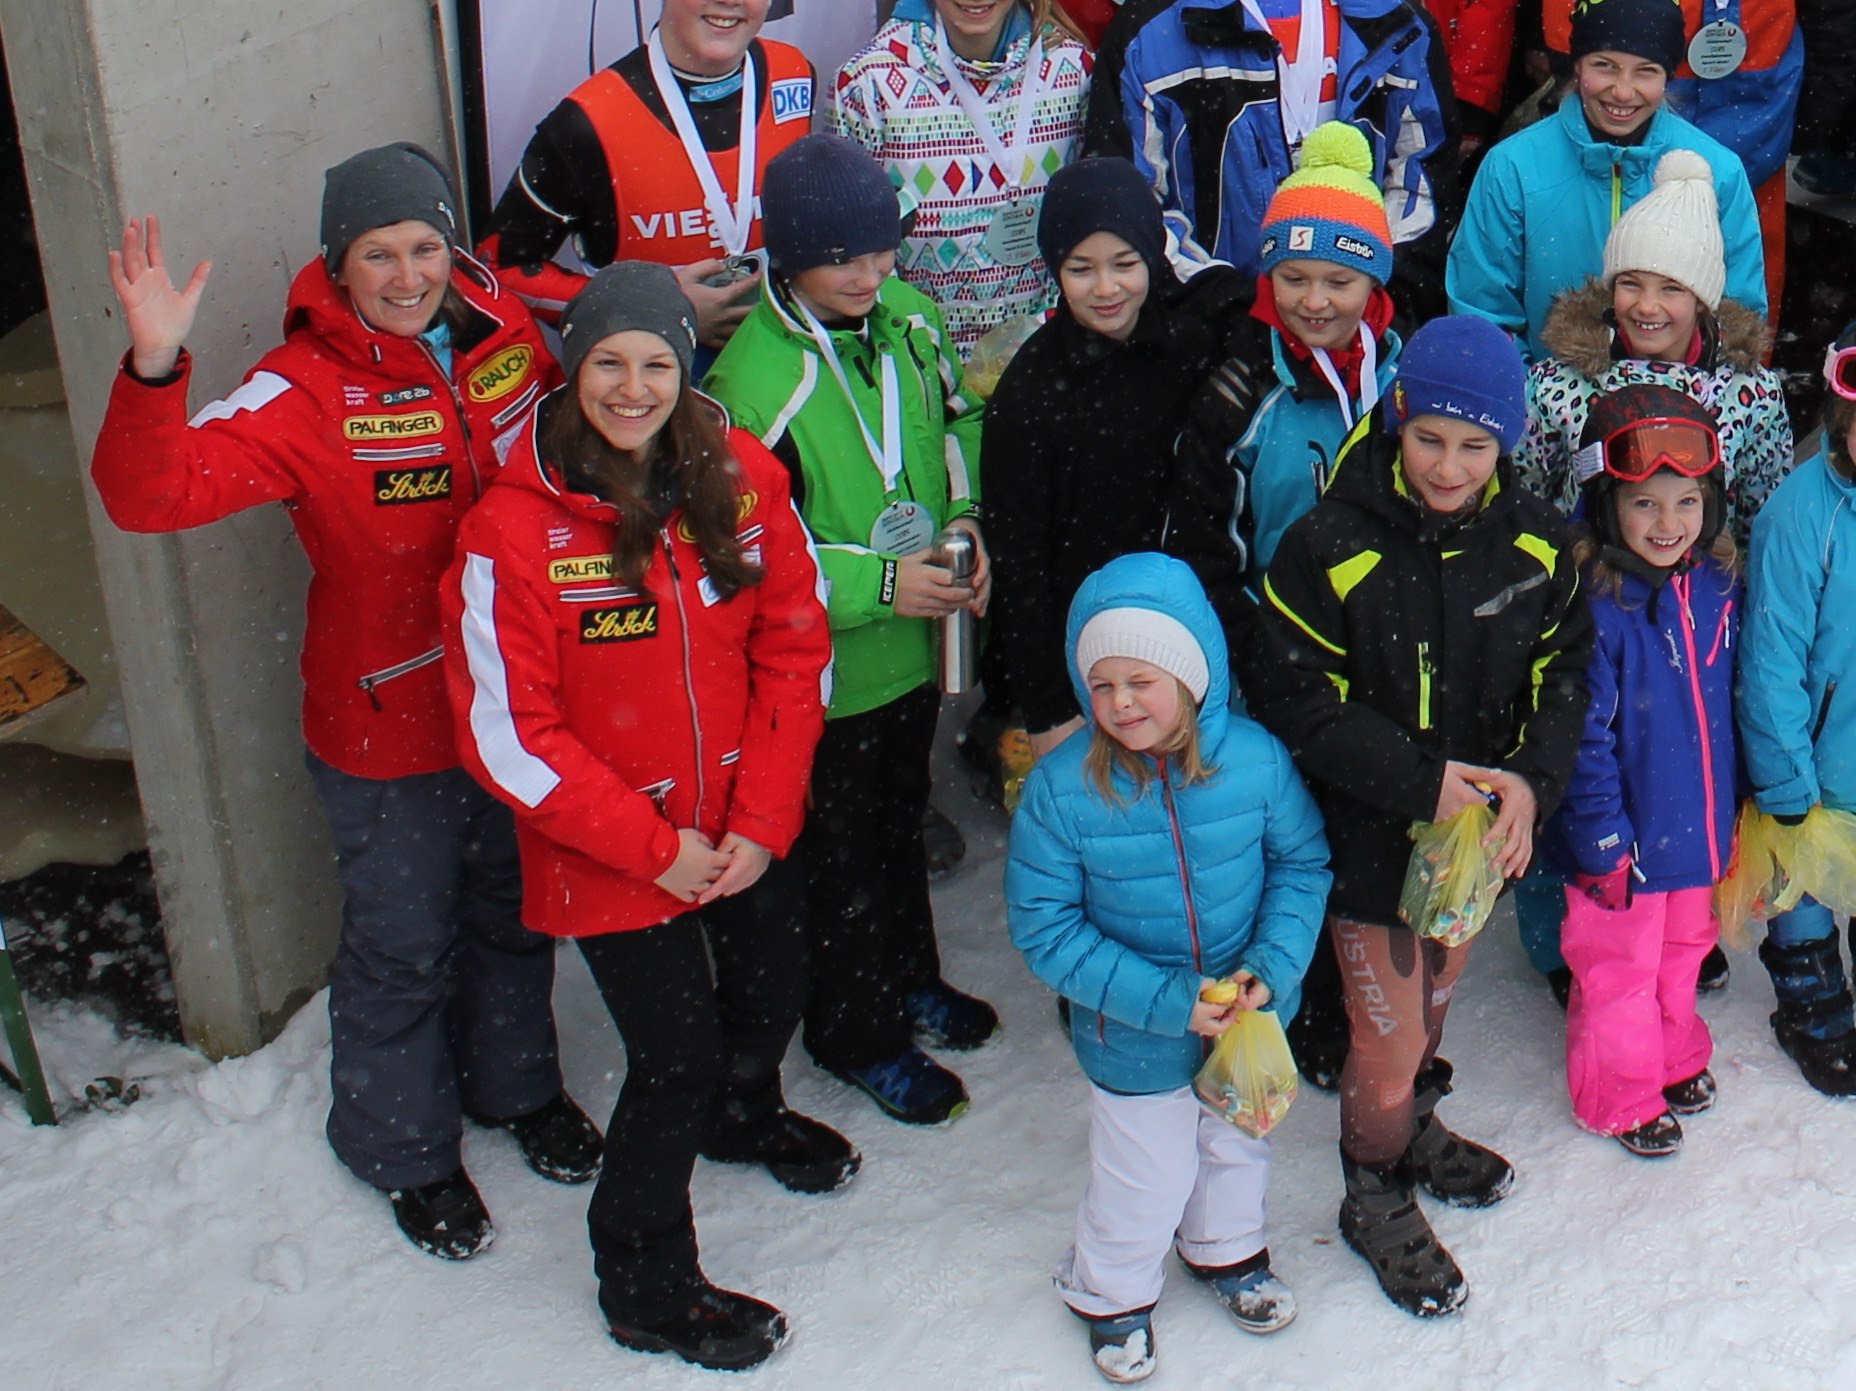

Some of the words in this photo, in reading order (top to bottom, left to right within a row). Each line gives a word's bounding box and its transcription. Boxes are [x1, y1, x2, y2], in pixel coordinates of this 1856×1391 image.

[773, 84, 811, 120] DKB
[1336, 237, 1374, 258] Eisbär
[482, 351, 528, 391] RAUCH
[349, 416, 437, 437] PALFINGER
[378, 470, 450, 502] Ströck
[554, 560, 611, 578] PALFIN
[584, 607, 656, 639] Ströck
[1336, 918, 1399, 1038] USTRIA
